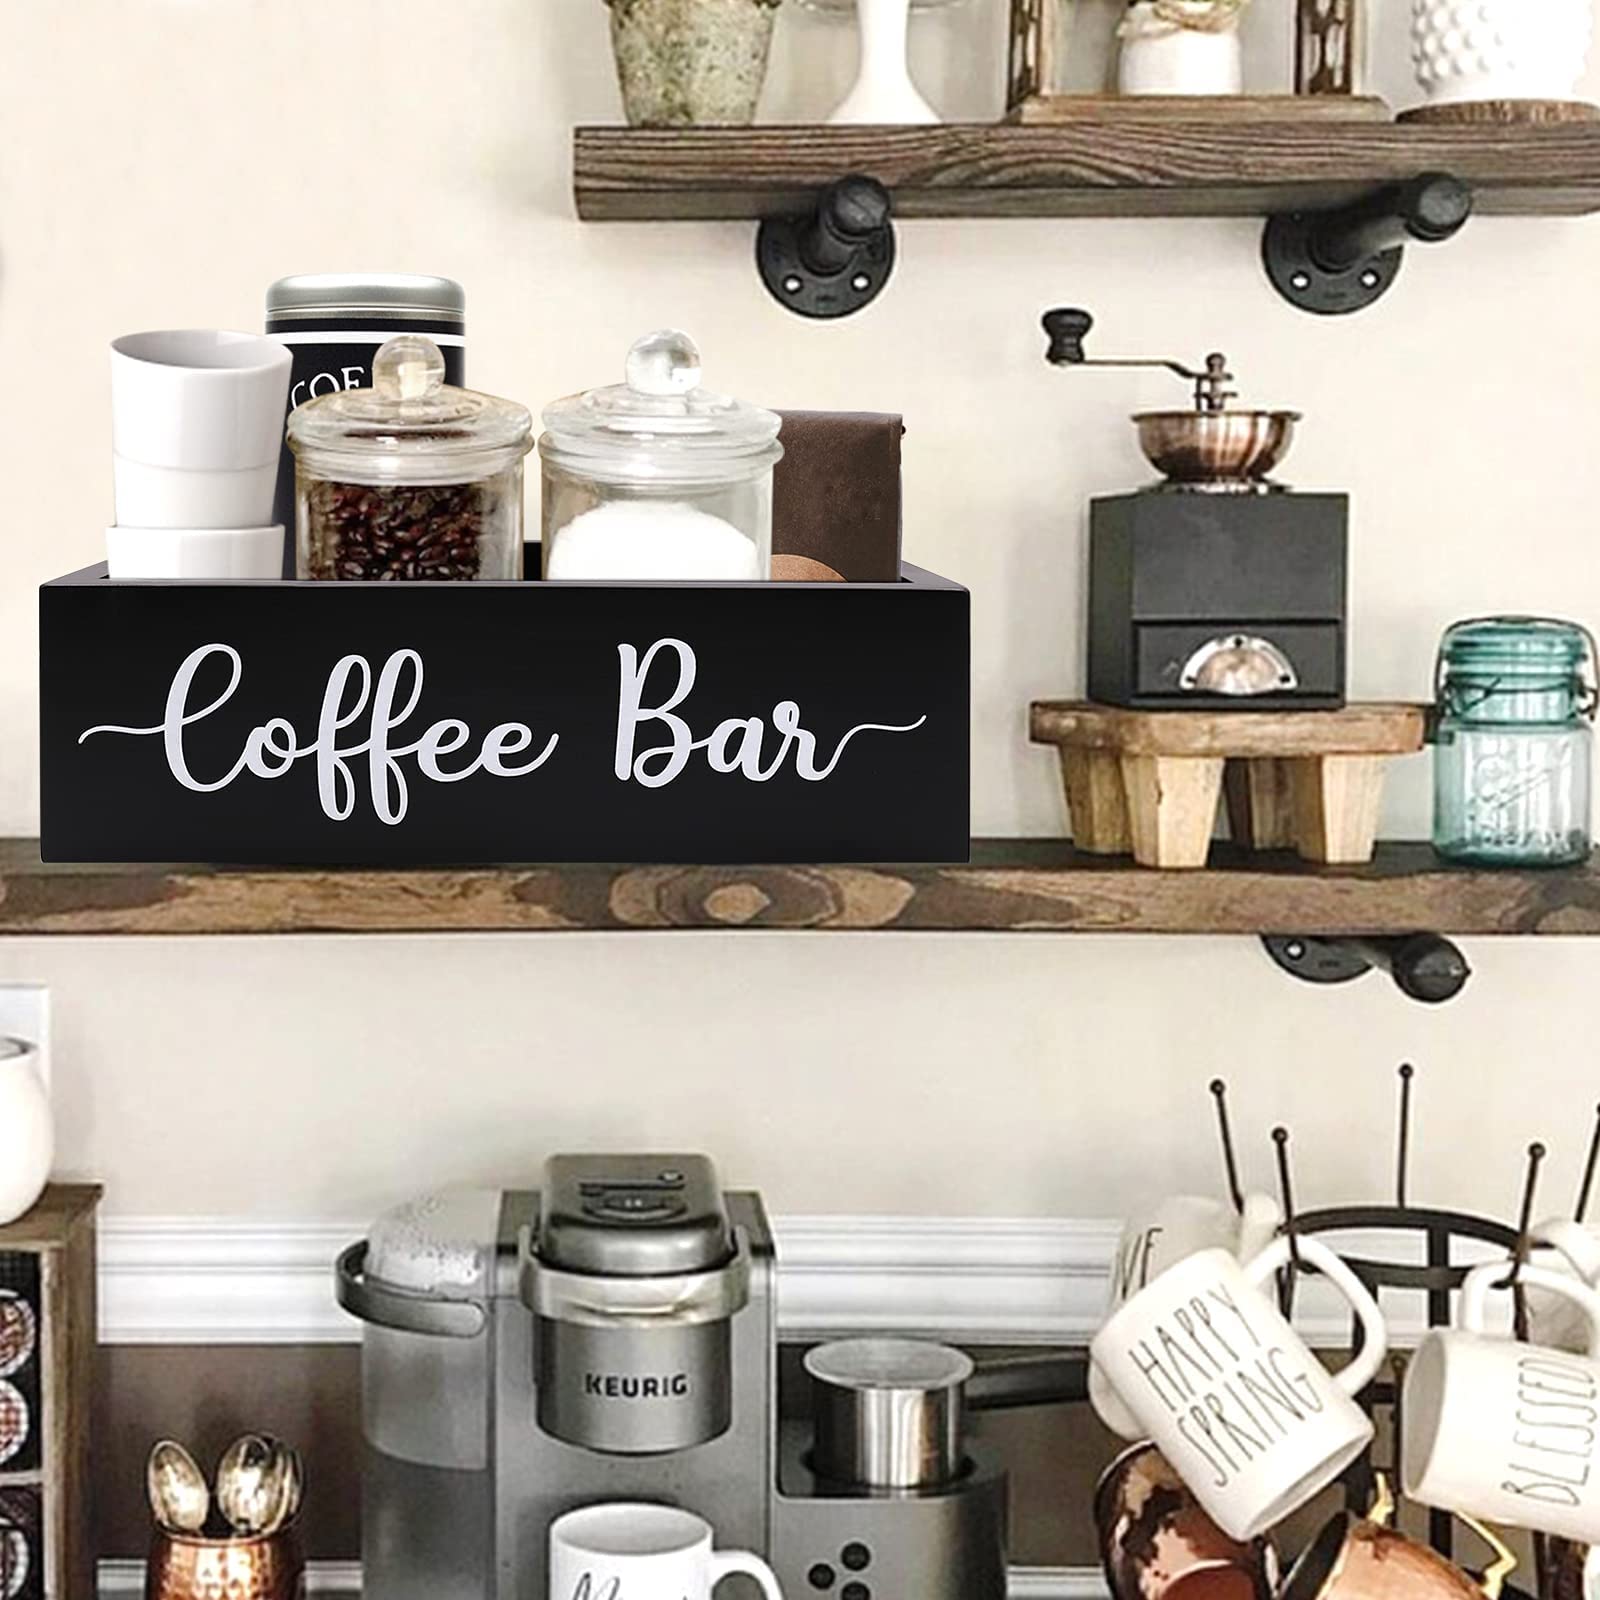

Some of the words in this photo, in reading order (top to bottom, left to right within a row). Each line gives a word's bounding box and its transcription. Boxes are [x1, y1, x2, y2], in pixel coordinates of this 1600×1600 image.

[78, 643, 560, 826] Coffee
[614, 637, 928, 788] Bar
[585, 1373, 687, 1398] KEURIG
[1128, 1282, 1261, 1412] HAPPY
[1177, 1347, 1324, 1488] SPRING
[1501, 1357, 1598, 1506] BLESSED
